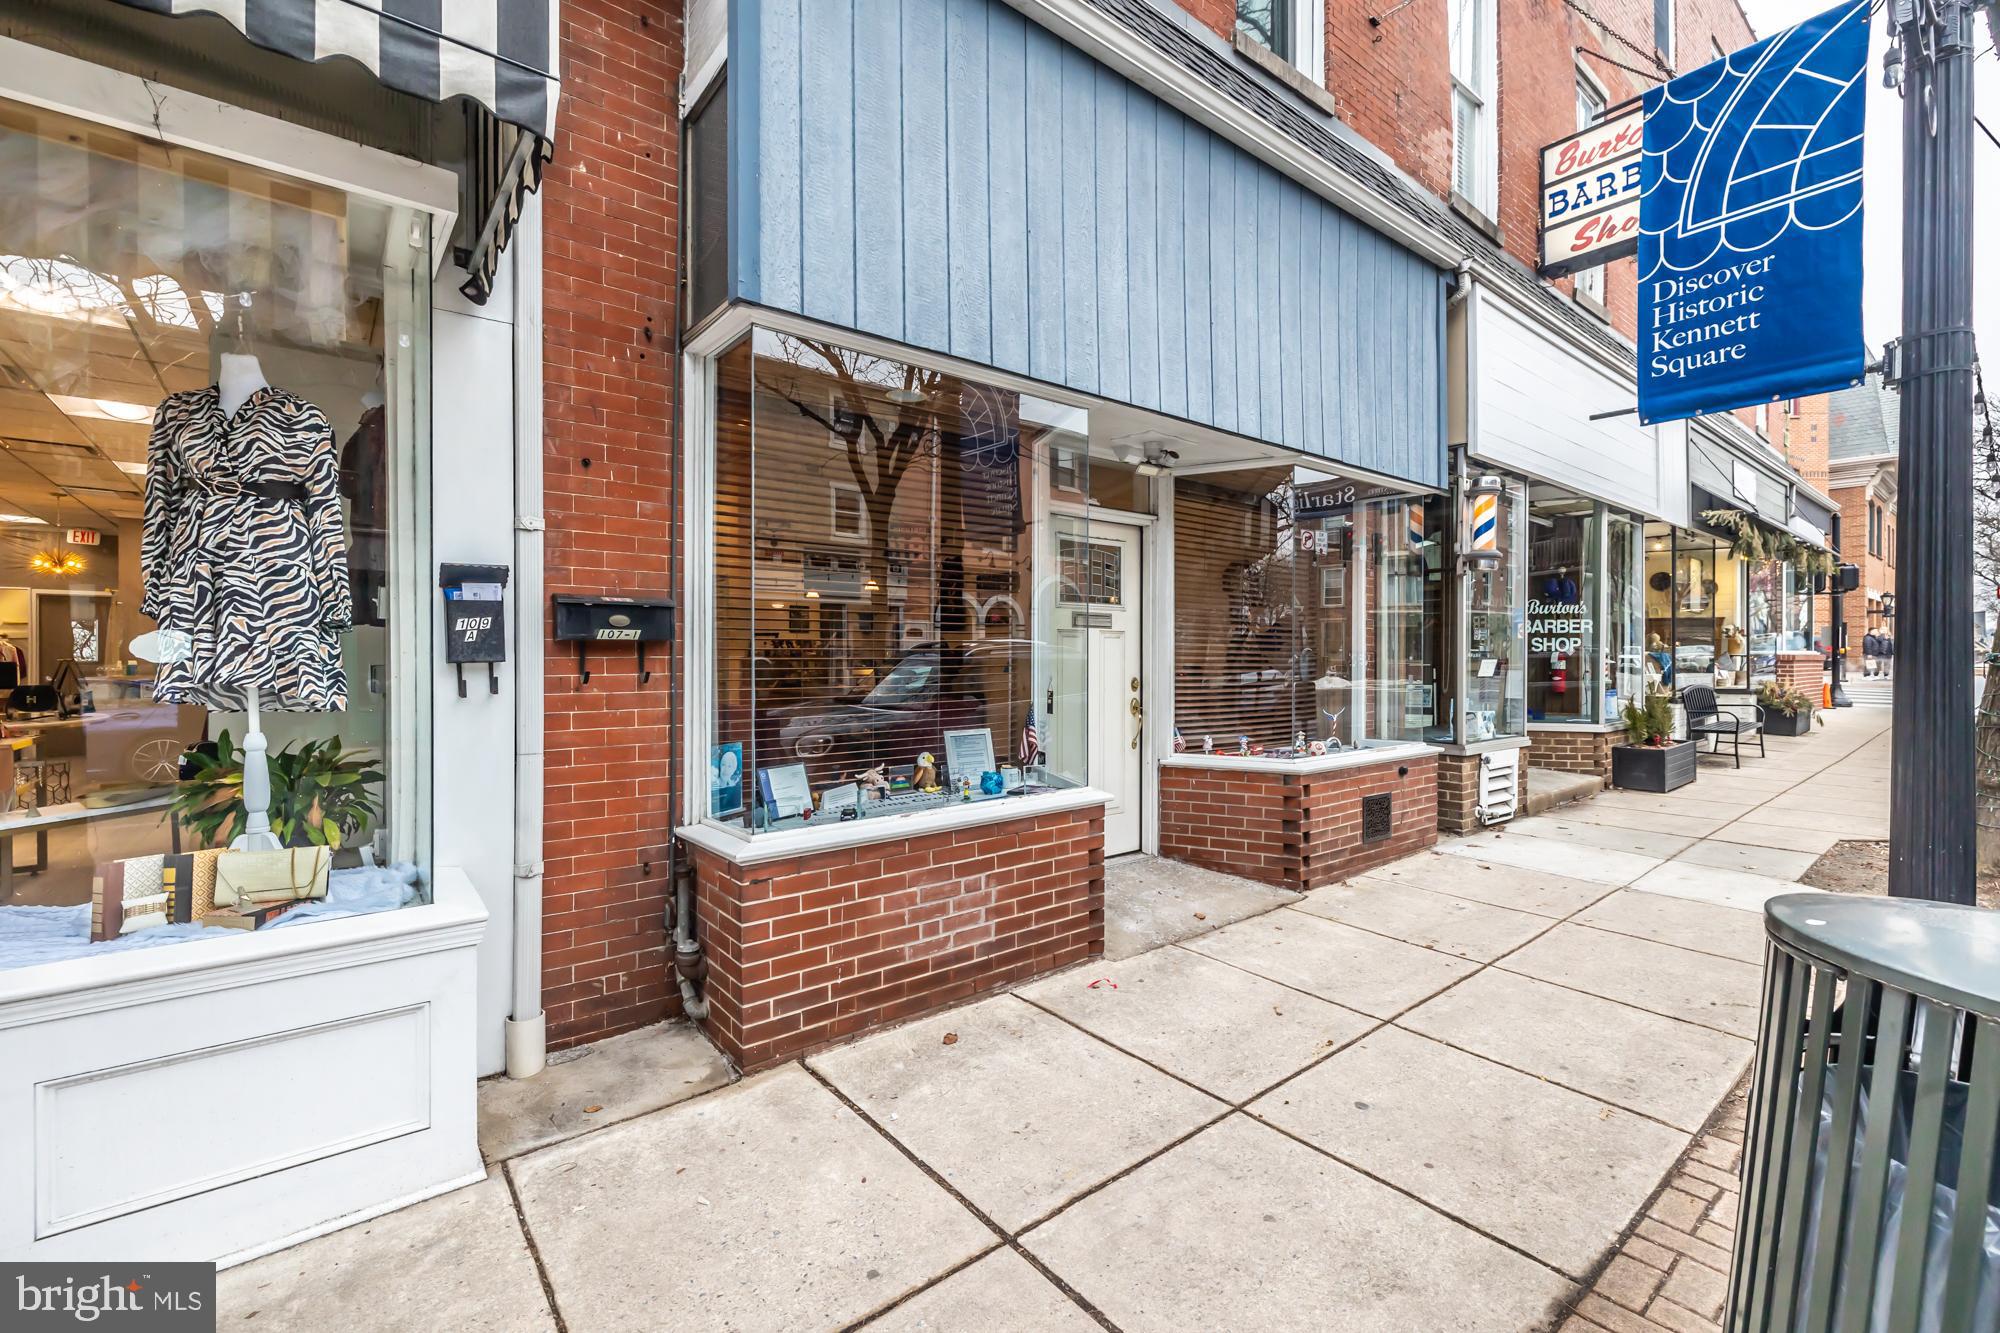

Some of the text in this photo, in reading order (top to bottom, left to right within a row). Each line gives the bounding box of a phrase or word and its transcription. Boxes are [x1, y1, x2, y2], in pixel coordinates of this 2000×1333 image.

[1555, 123, 1642, 176] Burto
[1548, 161, 1641, 219] BARB
[1652, 254, 1776, 304] Discover
[1652, 283, 1764, 329] Historic
[1652, 311, 1761, 354] Kennett
[1651, 343, 1747, 379] Square
[73, 530, 95, 544] EXIT
[1527, 598, 1588, 615] Burton's
[460, 618, 490, 629] 109
[1525, 619, 1594, 634] BARBER
[466, 630, 475, 641] A
[600, 630, 638, 639] 107-1
[1531, 637, 1582, 653] SHOP
